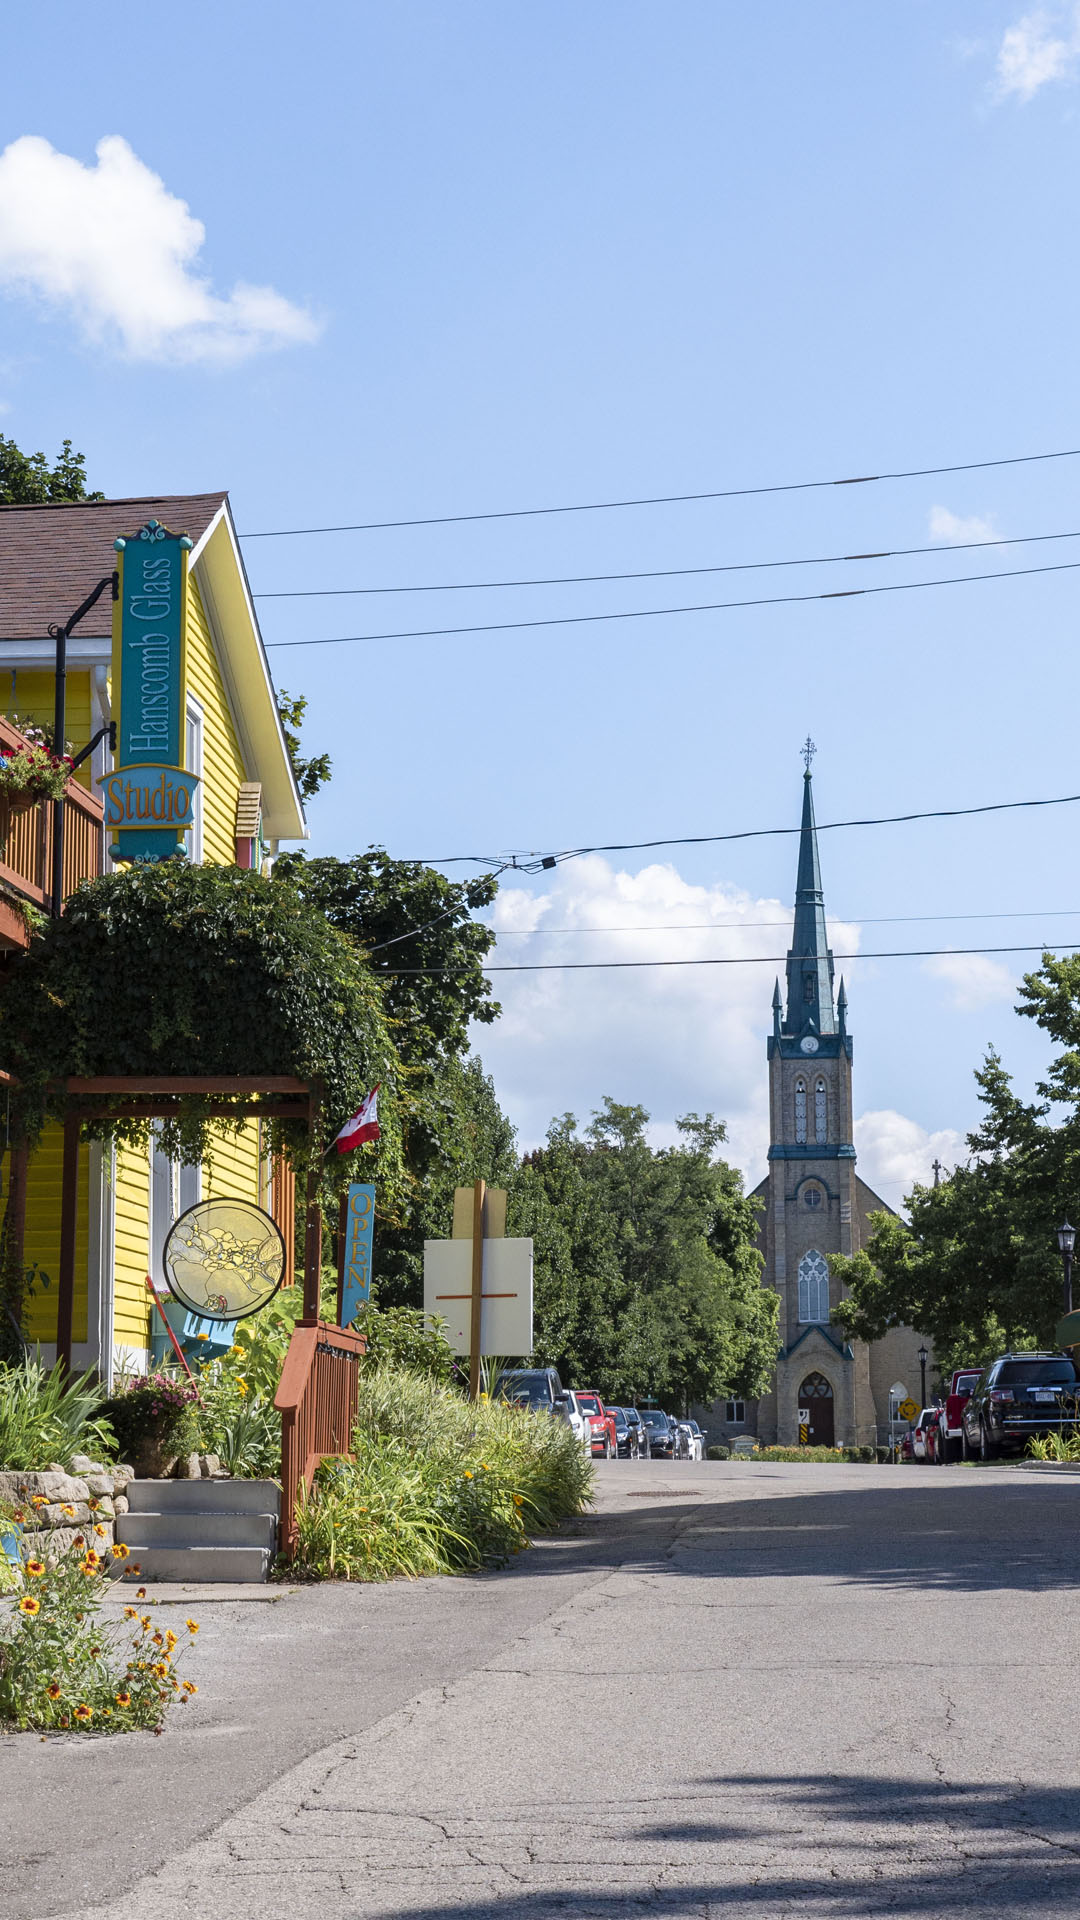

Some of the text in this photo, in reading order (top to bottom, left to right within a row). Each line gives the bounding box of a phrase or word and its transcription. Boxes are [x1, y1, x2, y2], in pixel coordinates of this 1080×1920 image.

[130, 558, 171, 752] Hanscomb Glass
[108, 773, 190, 824] Studio
[346, 1193, 371, 1289] OPEN
